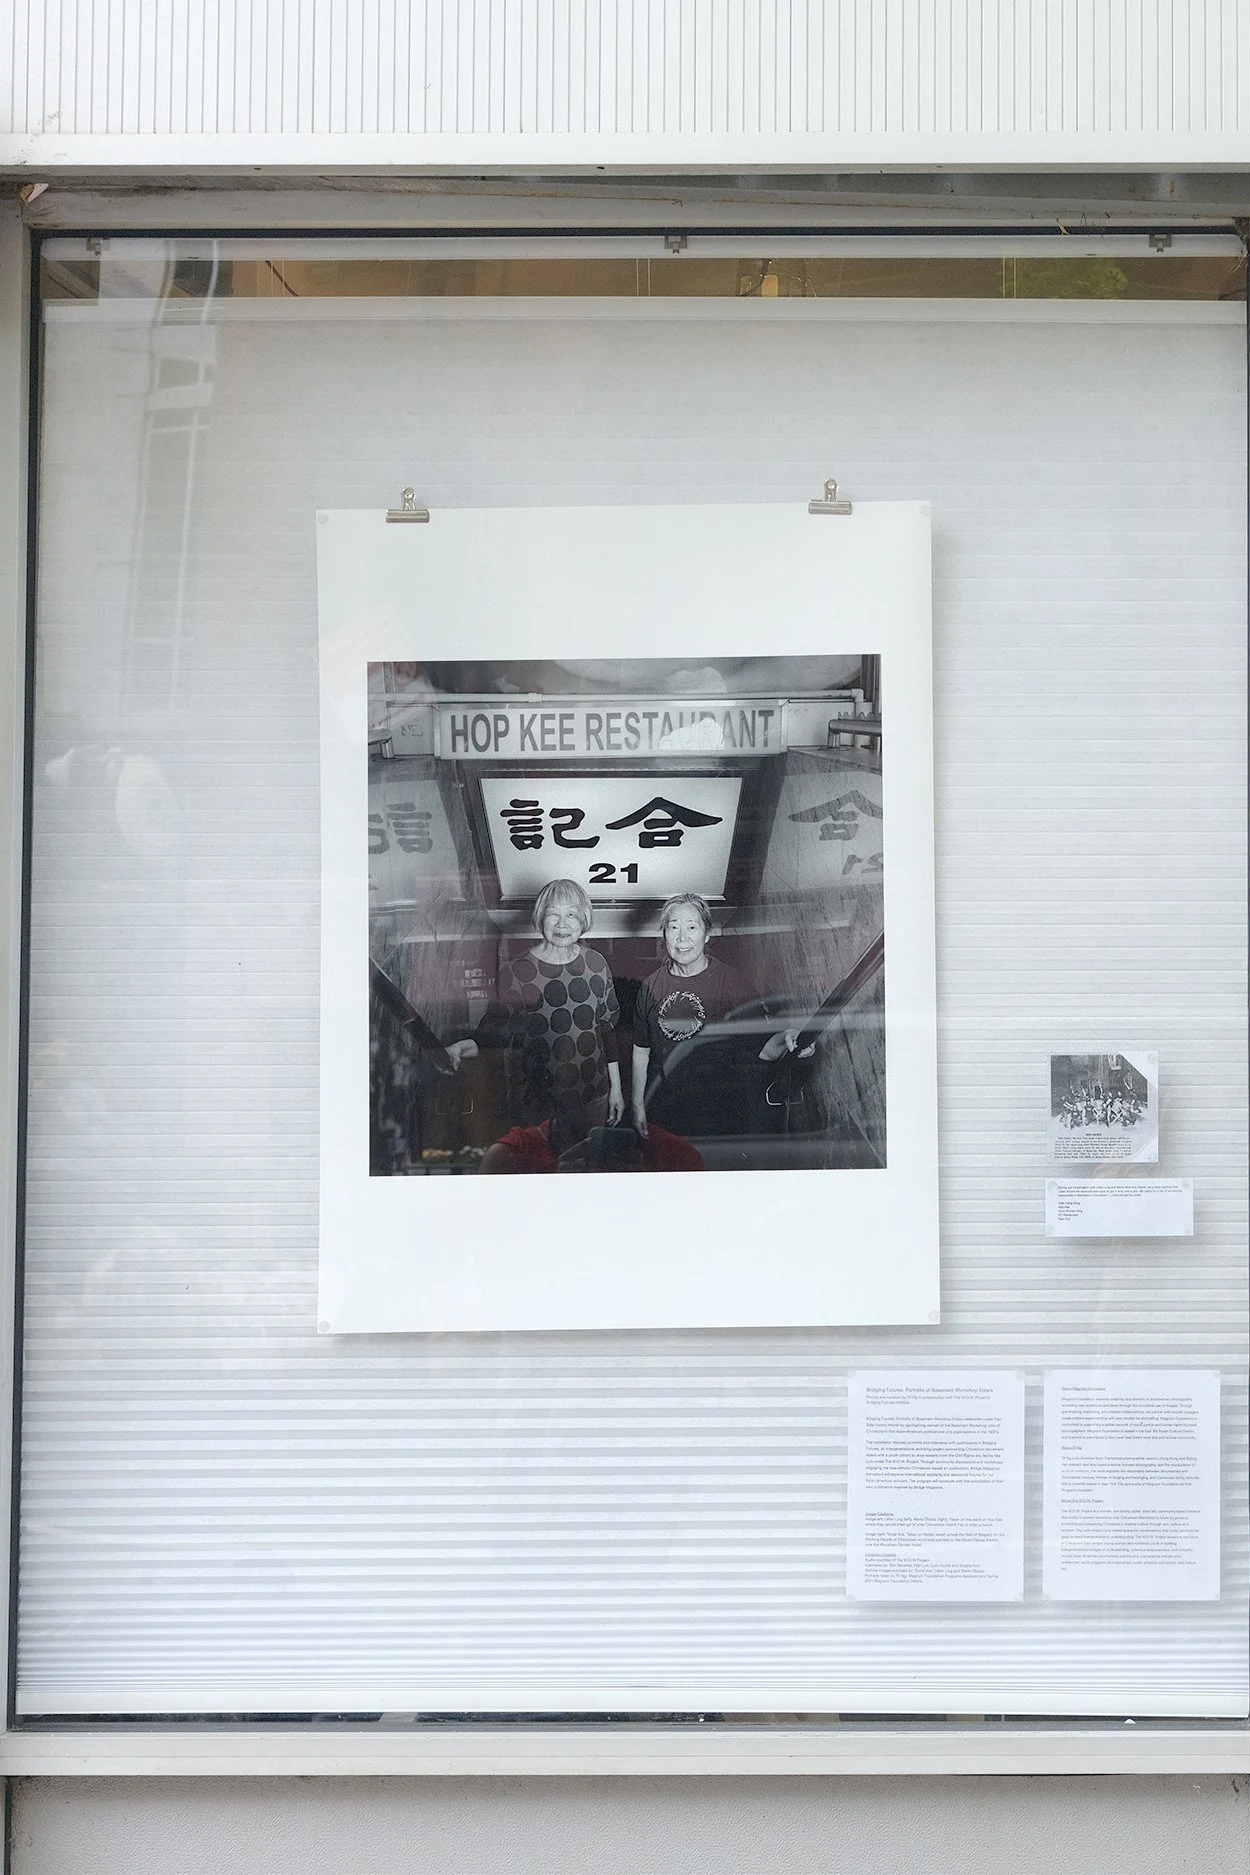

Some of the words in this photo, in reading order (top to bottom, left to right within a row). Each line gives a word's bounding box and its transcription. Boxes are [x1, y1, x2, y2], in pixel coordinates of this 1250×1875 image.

[451, 713, 509, 753] HOP
[520, 712, 575, 752] KEE
[588, 863, 638, 884] 21
